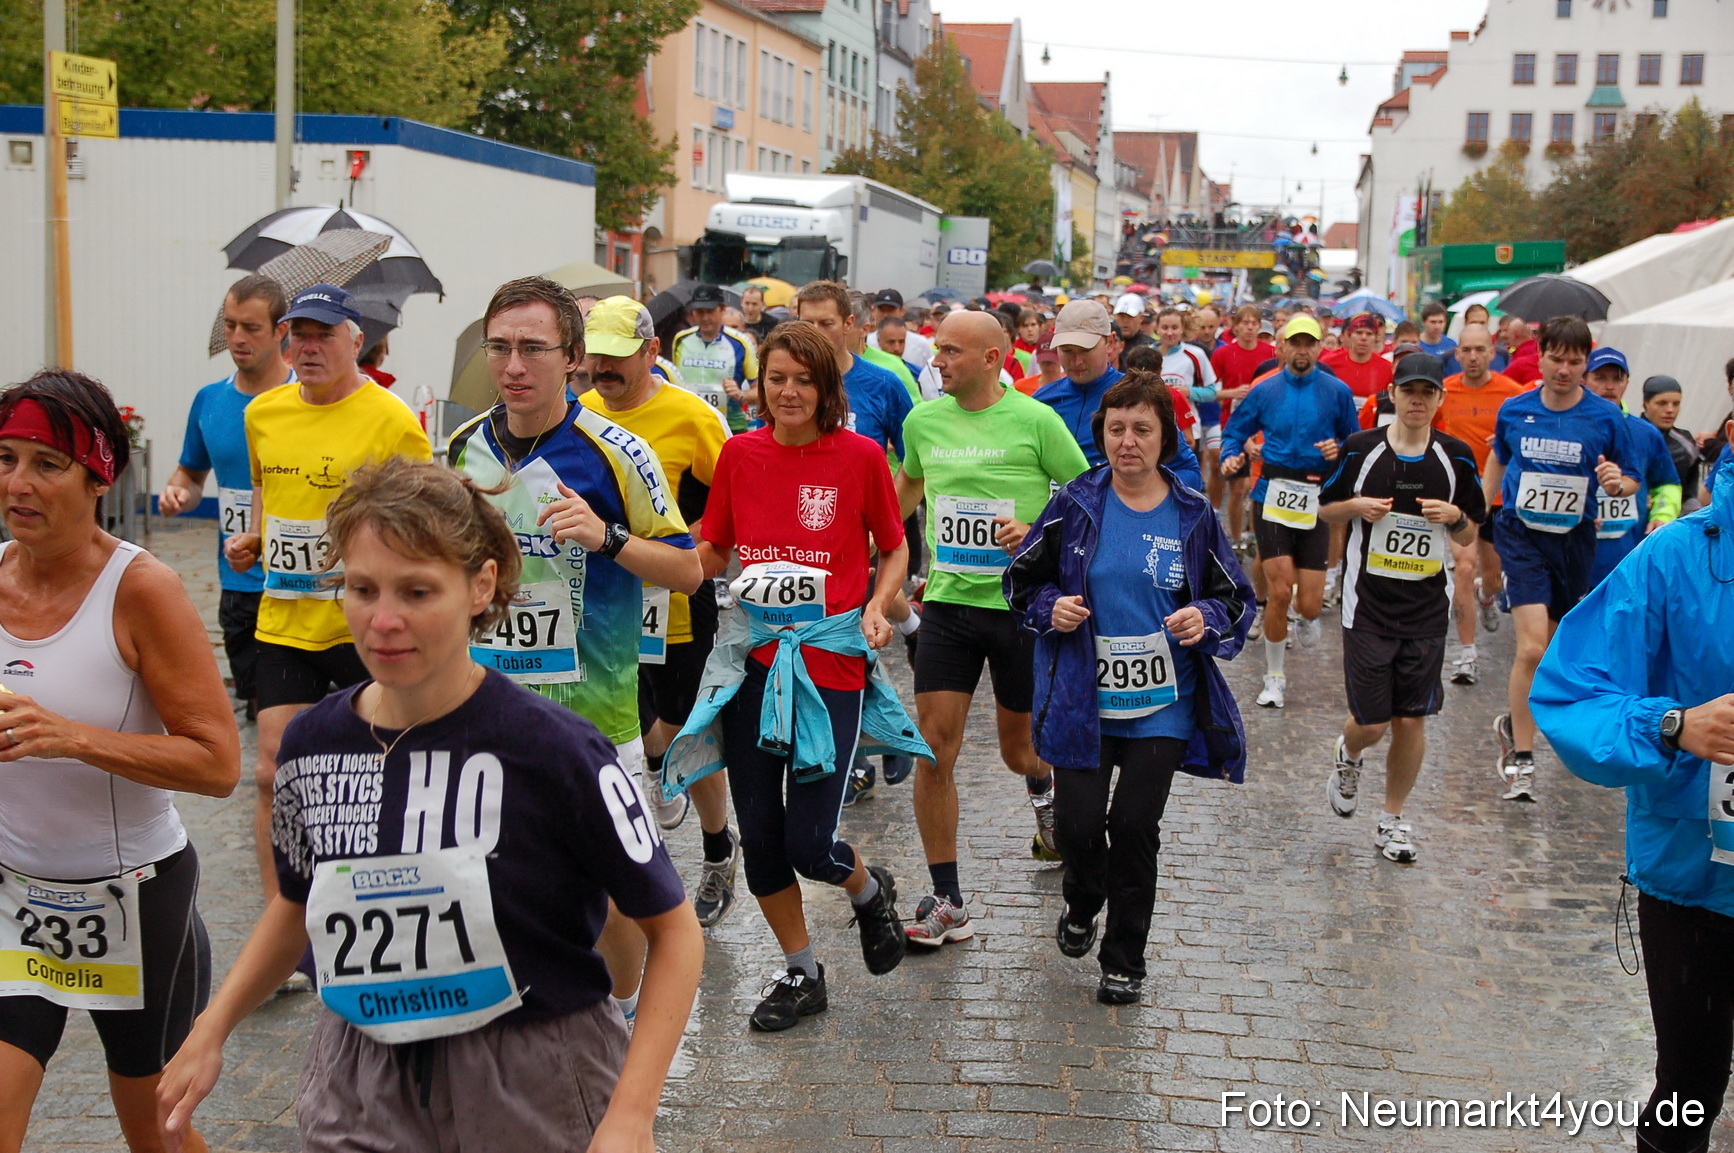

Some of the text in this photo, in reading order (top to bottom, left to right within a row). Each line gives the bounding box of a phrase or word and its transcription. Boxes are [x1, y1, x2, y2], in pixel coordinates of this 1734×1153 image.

[737, 214, 798, 230] BOCK
[1198, 254, 1236, 263] START
[683, 358, 726, 369] BOCK
[1520, 437, 1582, 456] HUBER
[599, 425, 668, 518] BOCK
[956, 502, 988, 511] BOCK
[1277, 491, 1308, 511] 824
[1523, 488, 1579, 512] 2172
[1396, 517, 1427, 528] BOCK
[514, 532, 561, 558] CK
[739, 545, 831, 564] Stadt-Team
[1385, 530, 1432, 558] 626
[952, 550, 990, 564] Helmut
[1383, 558, 1425, 572] Matthias
[740, 576, 816, 605] 2785
[763, 610, 793, 623] Anita
[1110, 642, 1146, 651] BOCK
[494, 654, 543, 670] Tobias
[1097, 655, 1167, 689] 2930
[1110, 695, 1152, 707] Christa
[298, 754, 341, 776] HOCKEY
[342, 753, 386, 773] HOCKEY
[325, 773, 384, 805] STYCS
[337, 802, 382, 824] HOCKEY
[324, 822, 379, 856] STYCS
[352, 866, 421, 889] BOCK
[28, 885, 87, 904] BOCK
[15, 906, 108, 961] 233
[325, 899, 476, 978] 2271
[27, 957, 104, 989] Cornelia
[359, 986, 469, 1019] Christine
